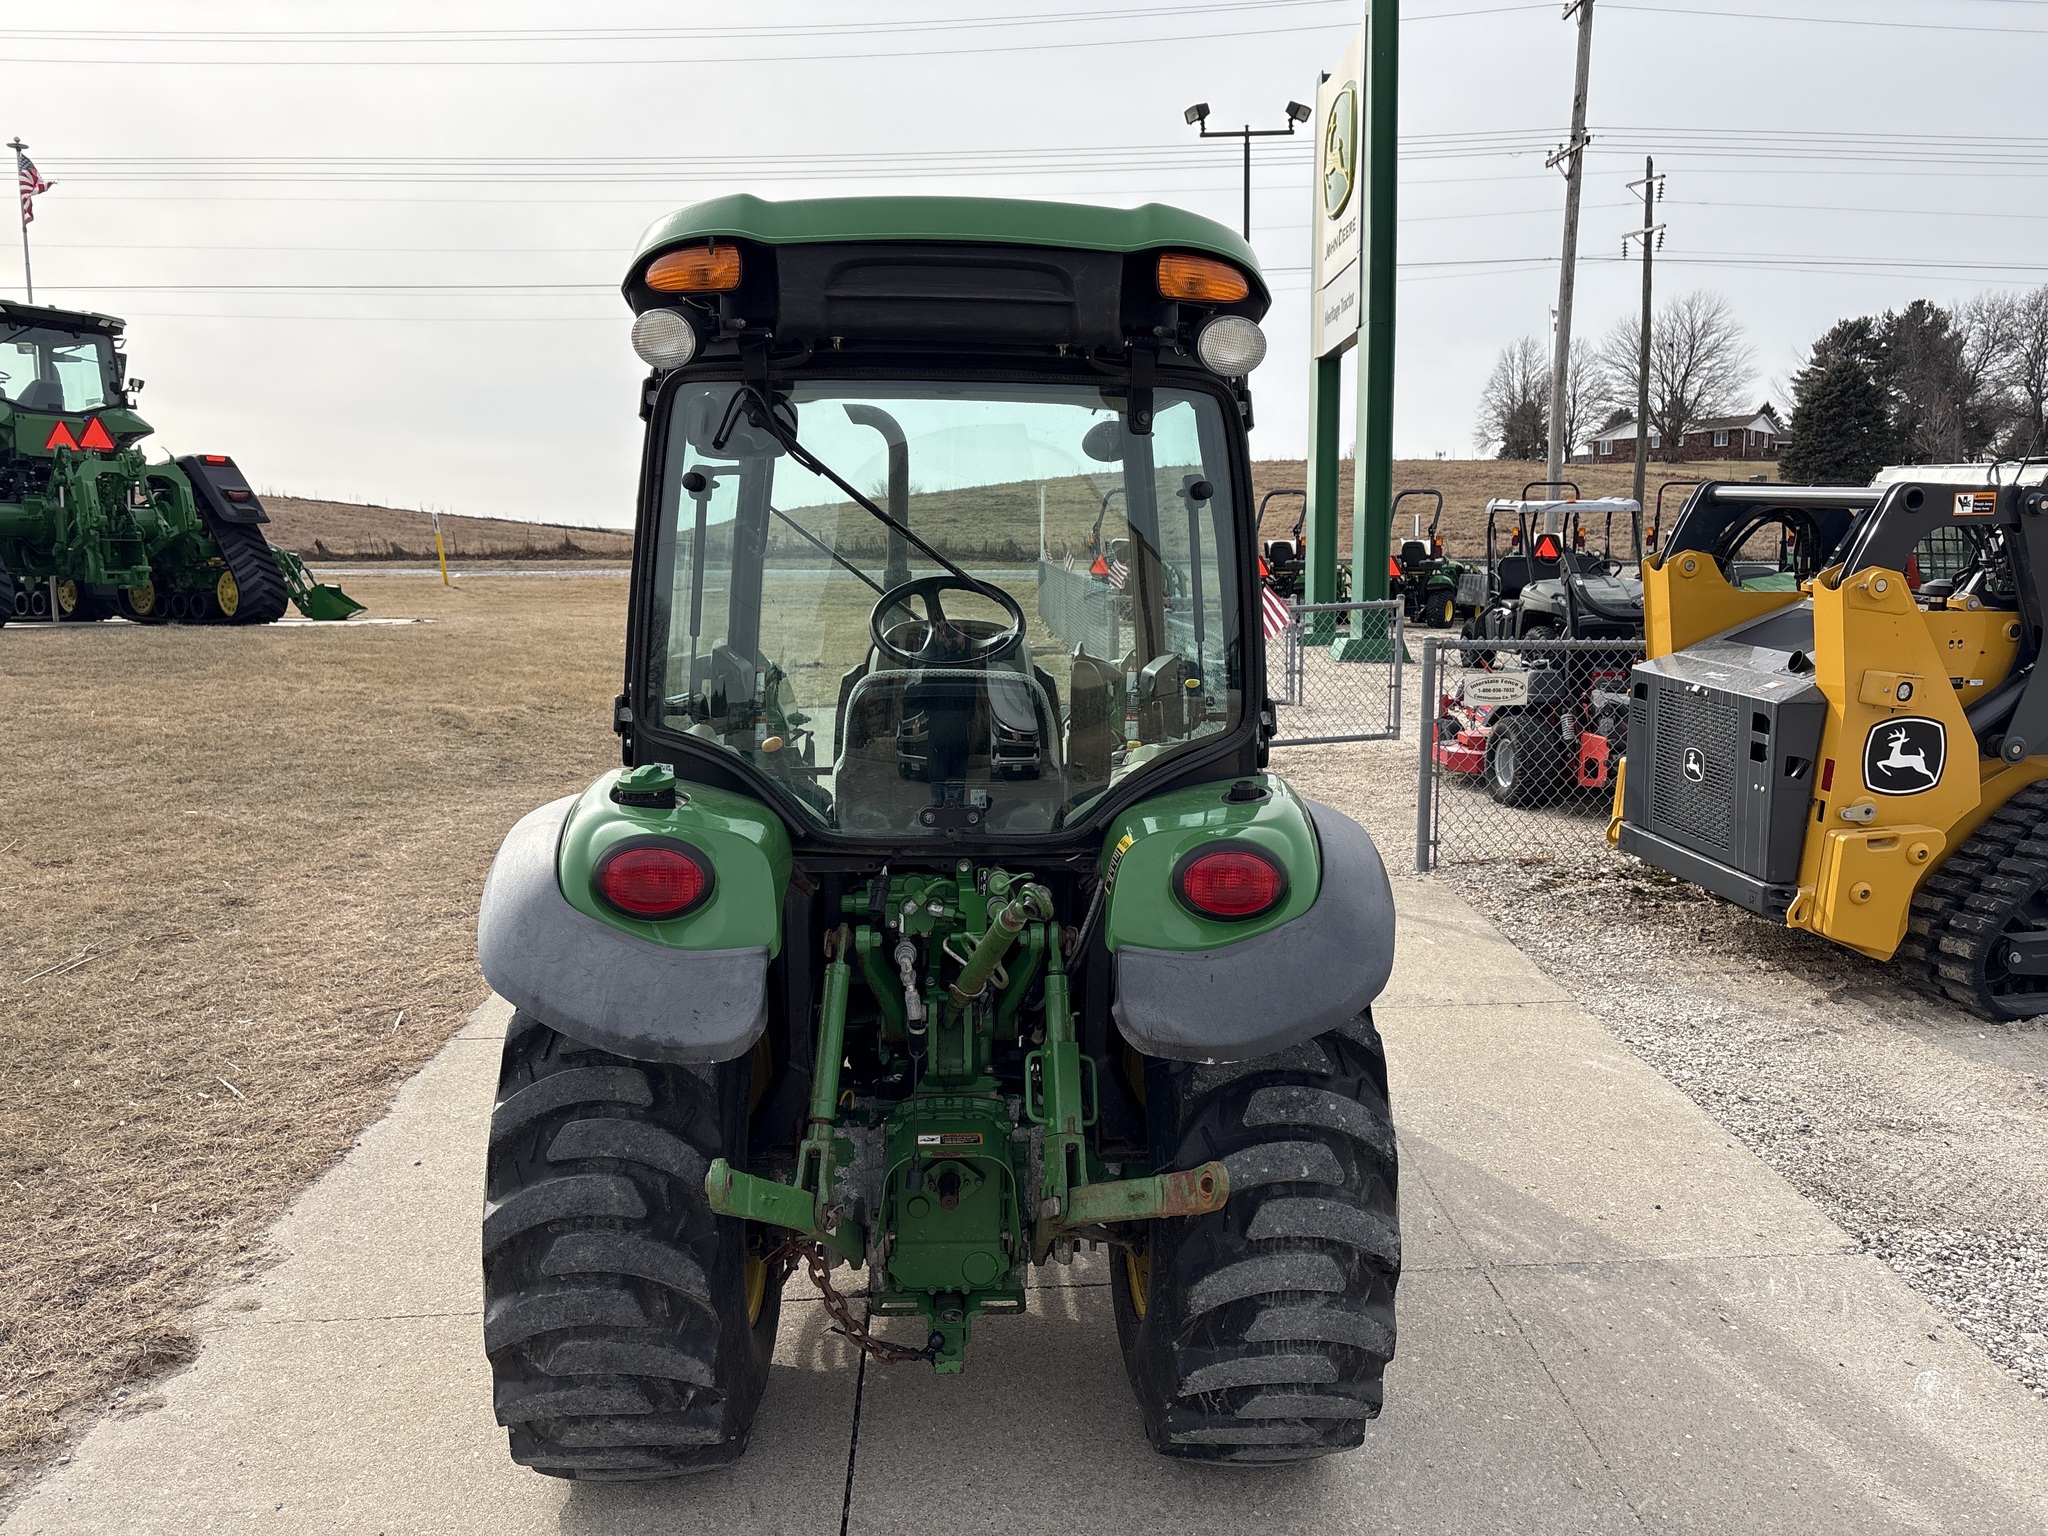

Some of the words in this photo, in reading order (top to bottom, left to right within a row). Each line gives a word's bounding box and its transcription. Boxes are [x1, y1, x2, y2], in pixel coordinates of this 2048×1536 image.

[1339, 216, 1356, 247] DEERE
[1470, 679, 1499, 689] Interstate
[1501, 679, 1519, 687] Fence
